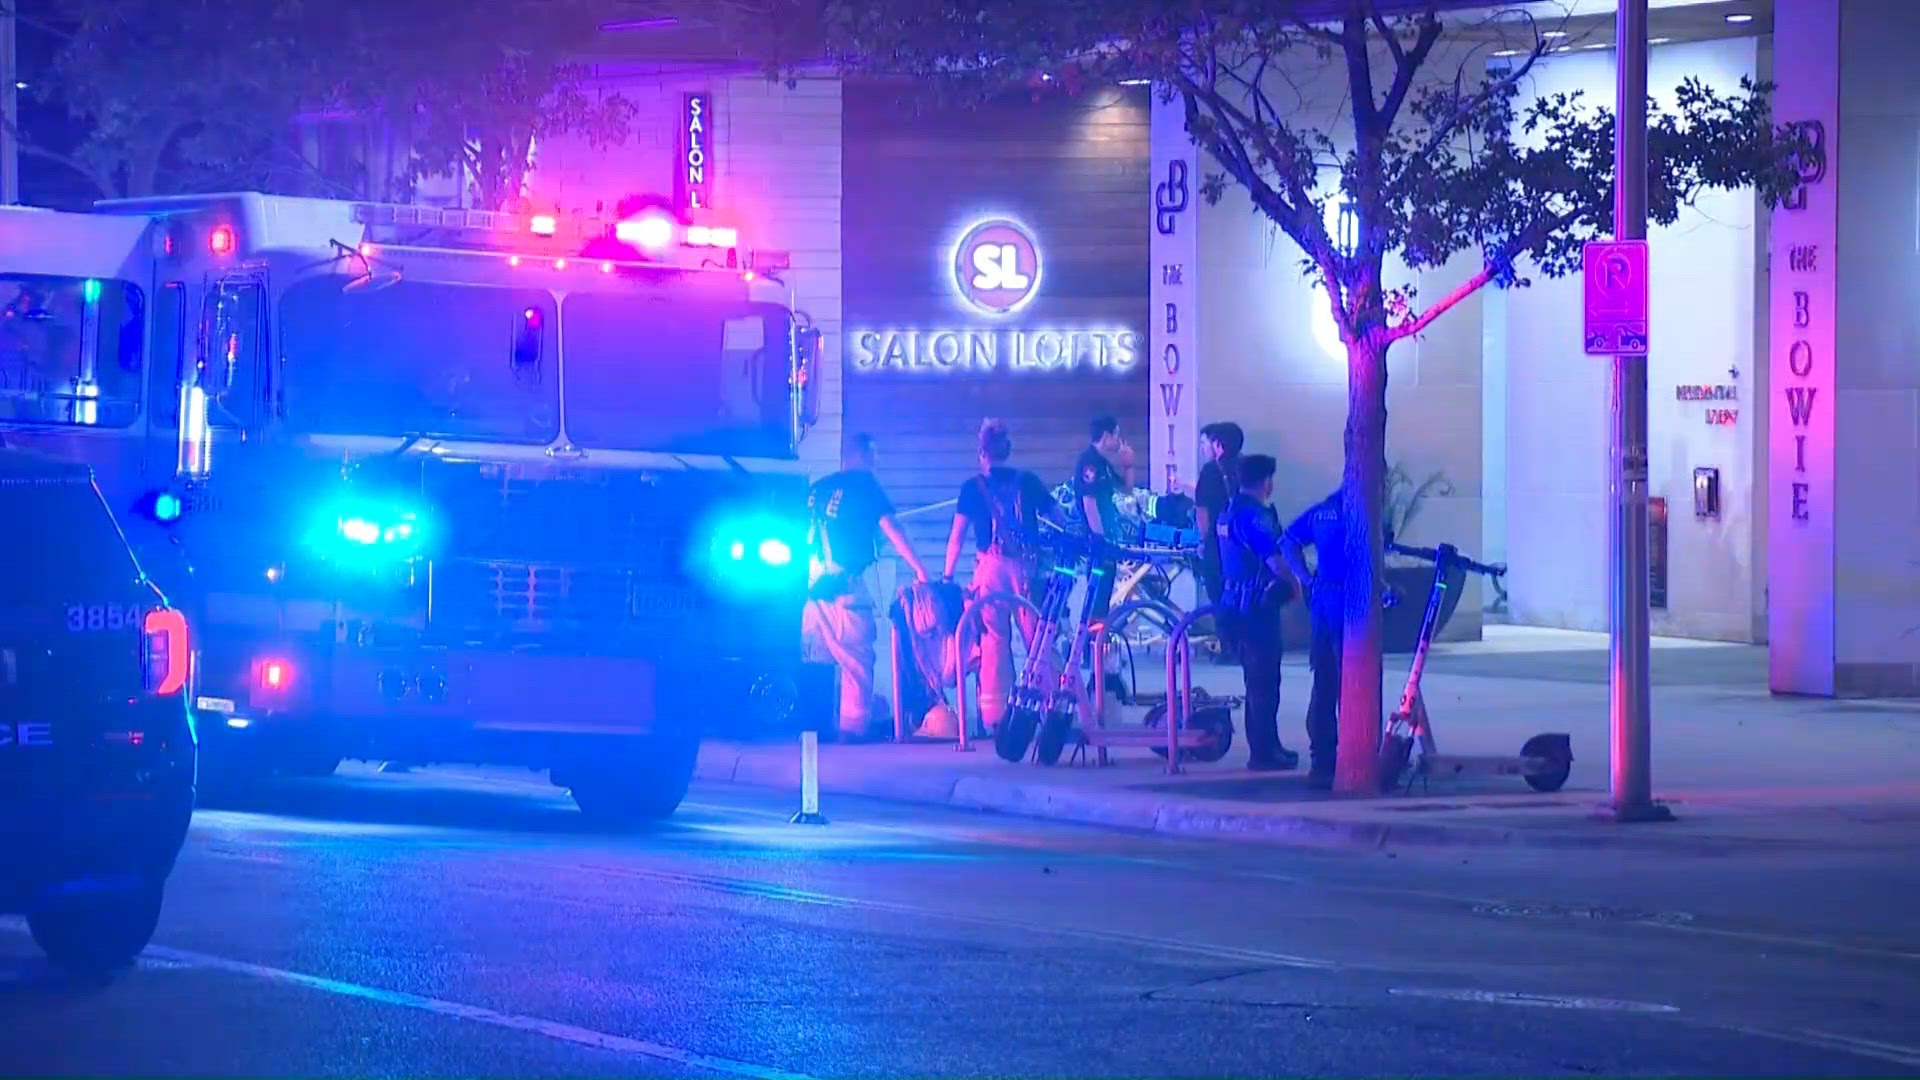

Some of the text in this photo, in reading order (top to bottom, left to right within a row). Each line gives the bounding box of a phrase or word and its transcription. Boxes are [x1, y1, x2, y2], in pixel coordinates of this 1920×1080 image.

[688, 98, 704, 184] SALON
[972, 244, 1029, 290] SL
[859, 331, 1138, 368] SALON LOFTS
[1159, 302, 1184, 495] BOWIE
[1785, 290, 1818, 522] BOWIE
[66, 602, 142, 632] 3854
